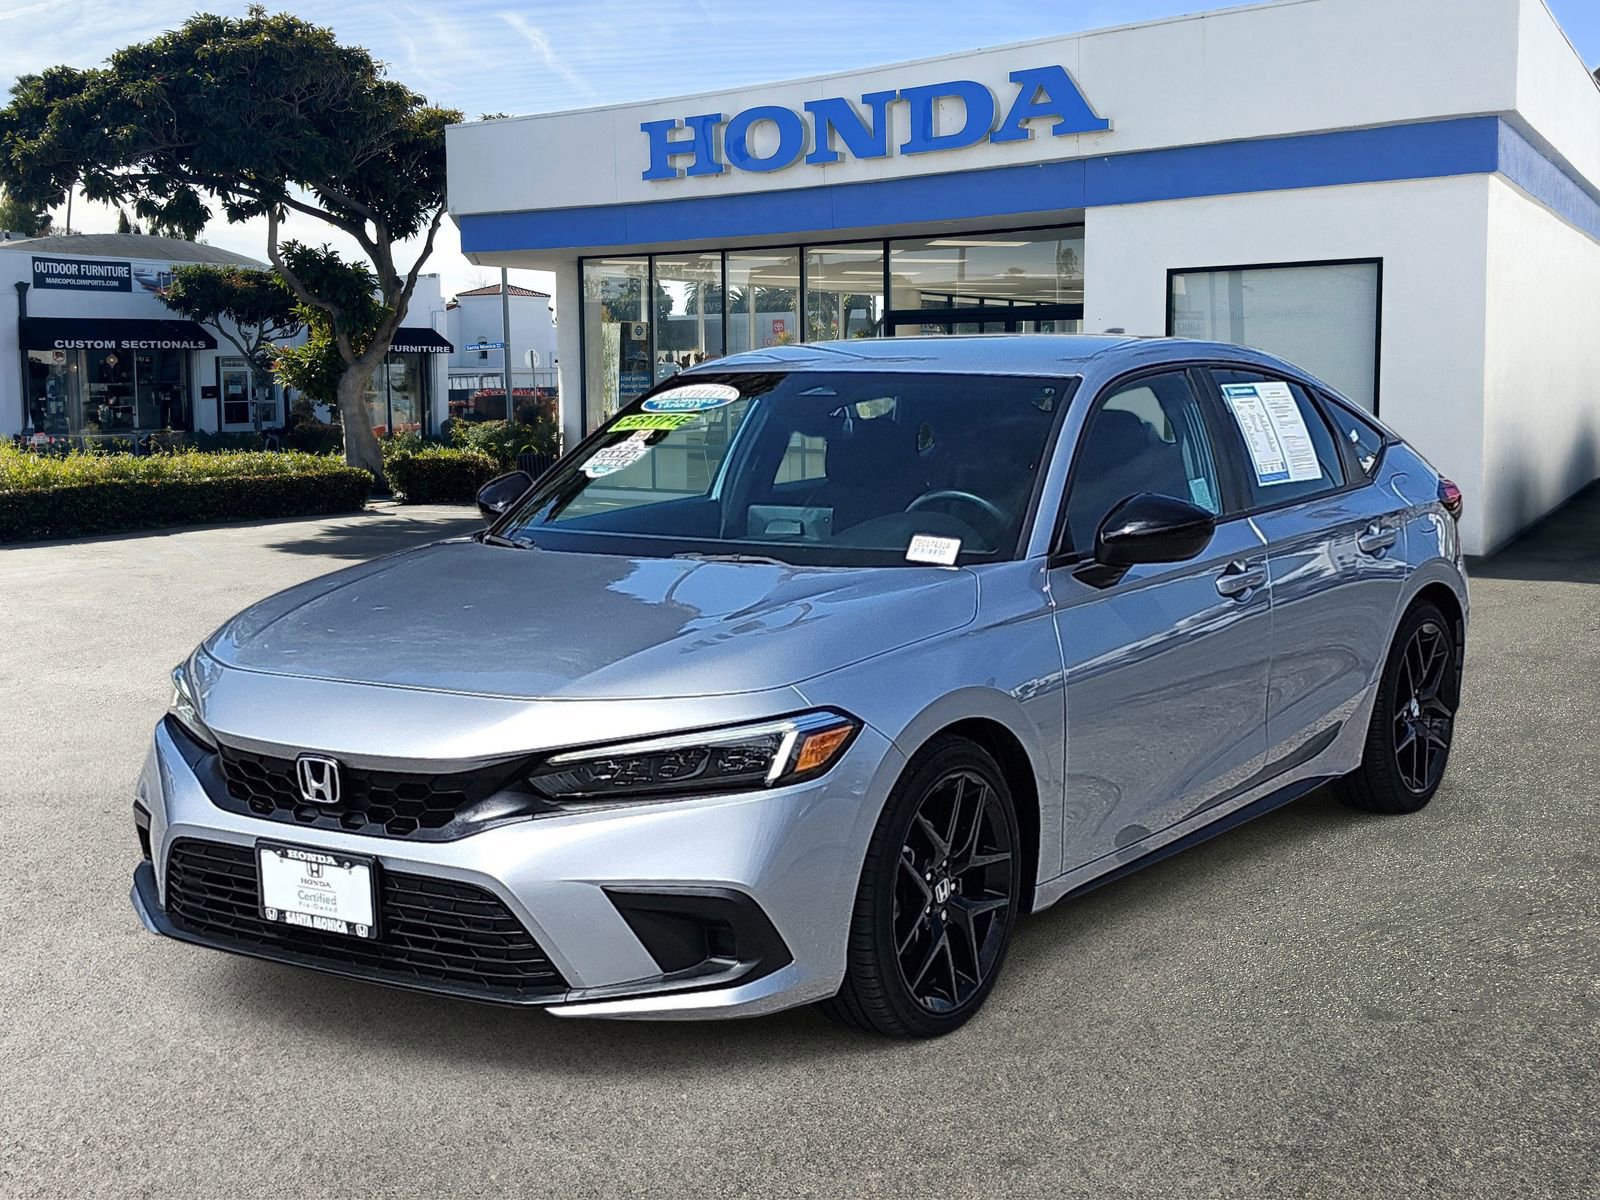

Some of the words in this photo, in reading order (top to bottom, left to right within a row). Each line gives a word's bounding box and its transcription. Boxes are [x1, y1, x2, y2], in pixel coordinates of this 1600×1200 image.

[640, 65, 1110, 181] HONDA
[34, 261, 79, 275] OUTDOOR
[80, 264, 130, 278] FURNITURE
[45, 277, 119, 287] MARCOPOLOIMPORTS.COM
[54, 340, 116, 349] CUSTOM
[121, 340, 206, 349] SECTIONALS
[388, 344, 450, 353] FURNITURE
[286, 849, 338, 866] HONDA
[300, 877, 332, 889] HONDA
[297, 890, 337, 906] Certified
[298, 901, 338, 913] Pre-Owned
[285, 911, 313, 928] SANTA
[313, 915, 348, 935] MONICA
